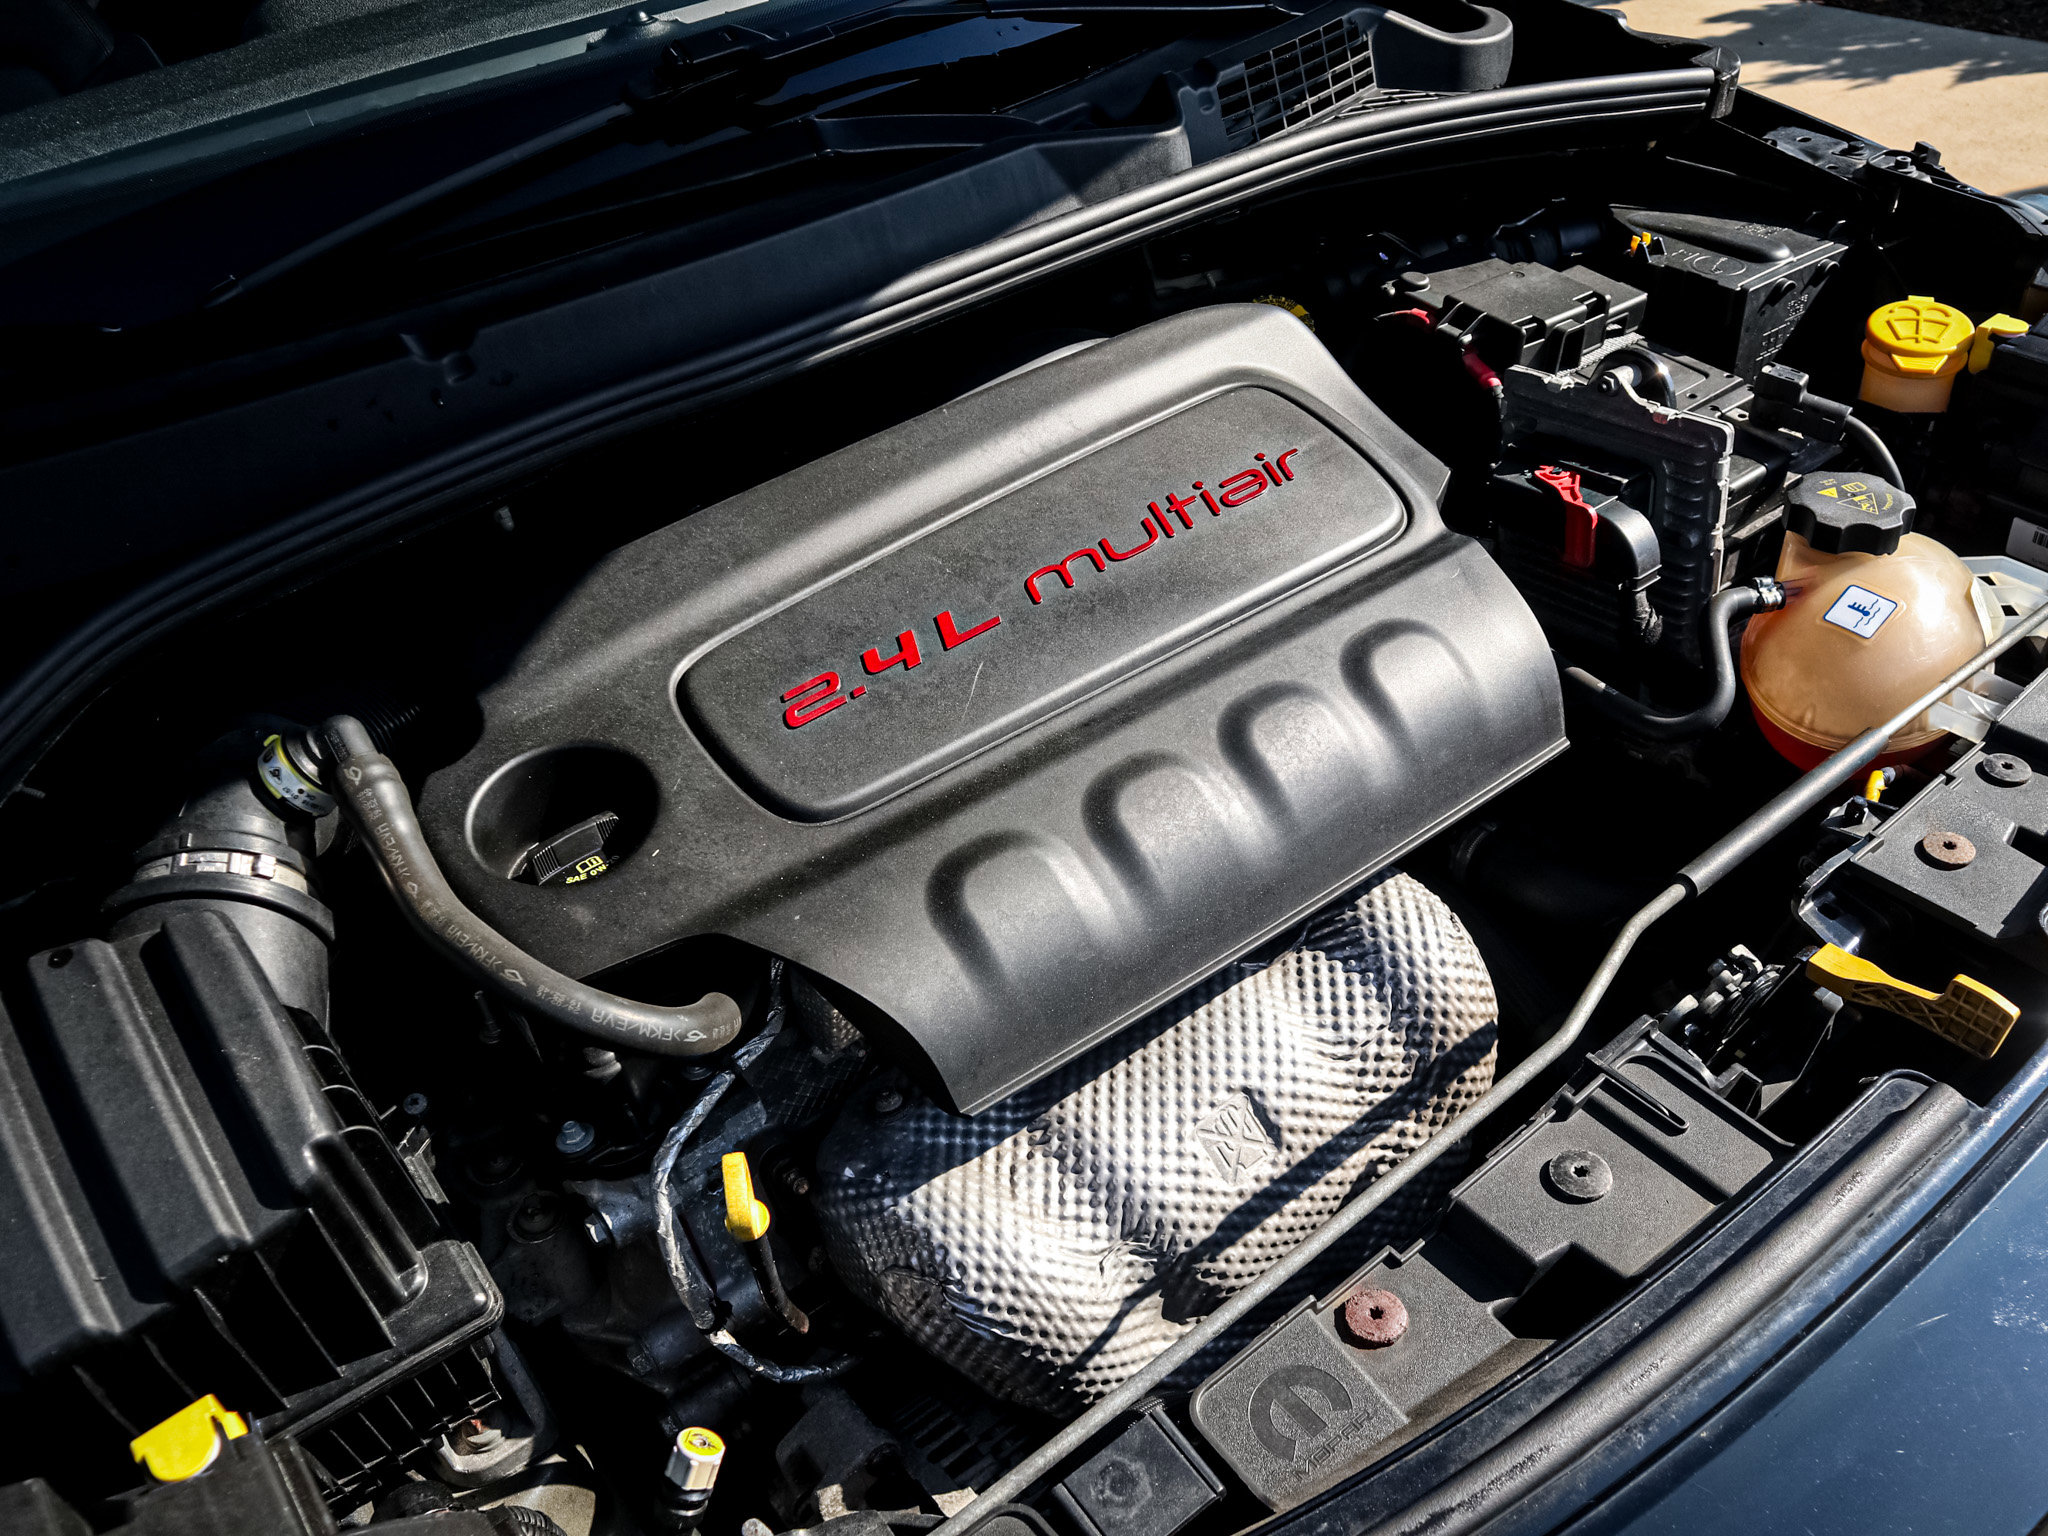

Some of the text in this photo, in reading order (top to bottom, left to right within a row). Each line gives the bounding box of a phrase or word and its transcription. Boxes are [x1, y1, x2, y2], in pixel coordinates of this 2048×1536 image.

[780, 447, 1299, 729] 2.4 L multiair
[565, 872, 588, 884] SAE
[1291, 1409, 1374, 1481] MOPAR
